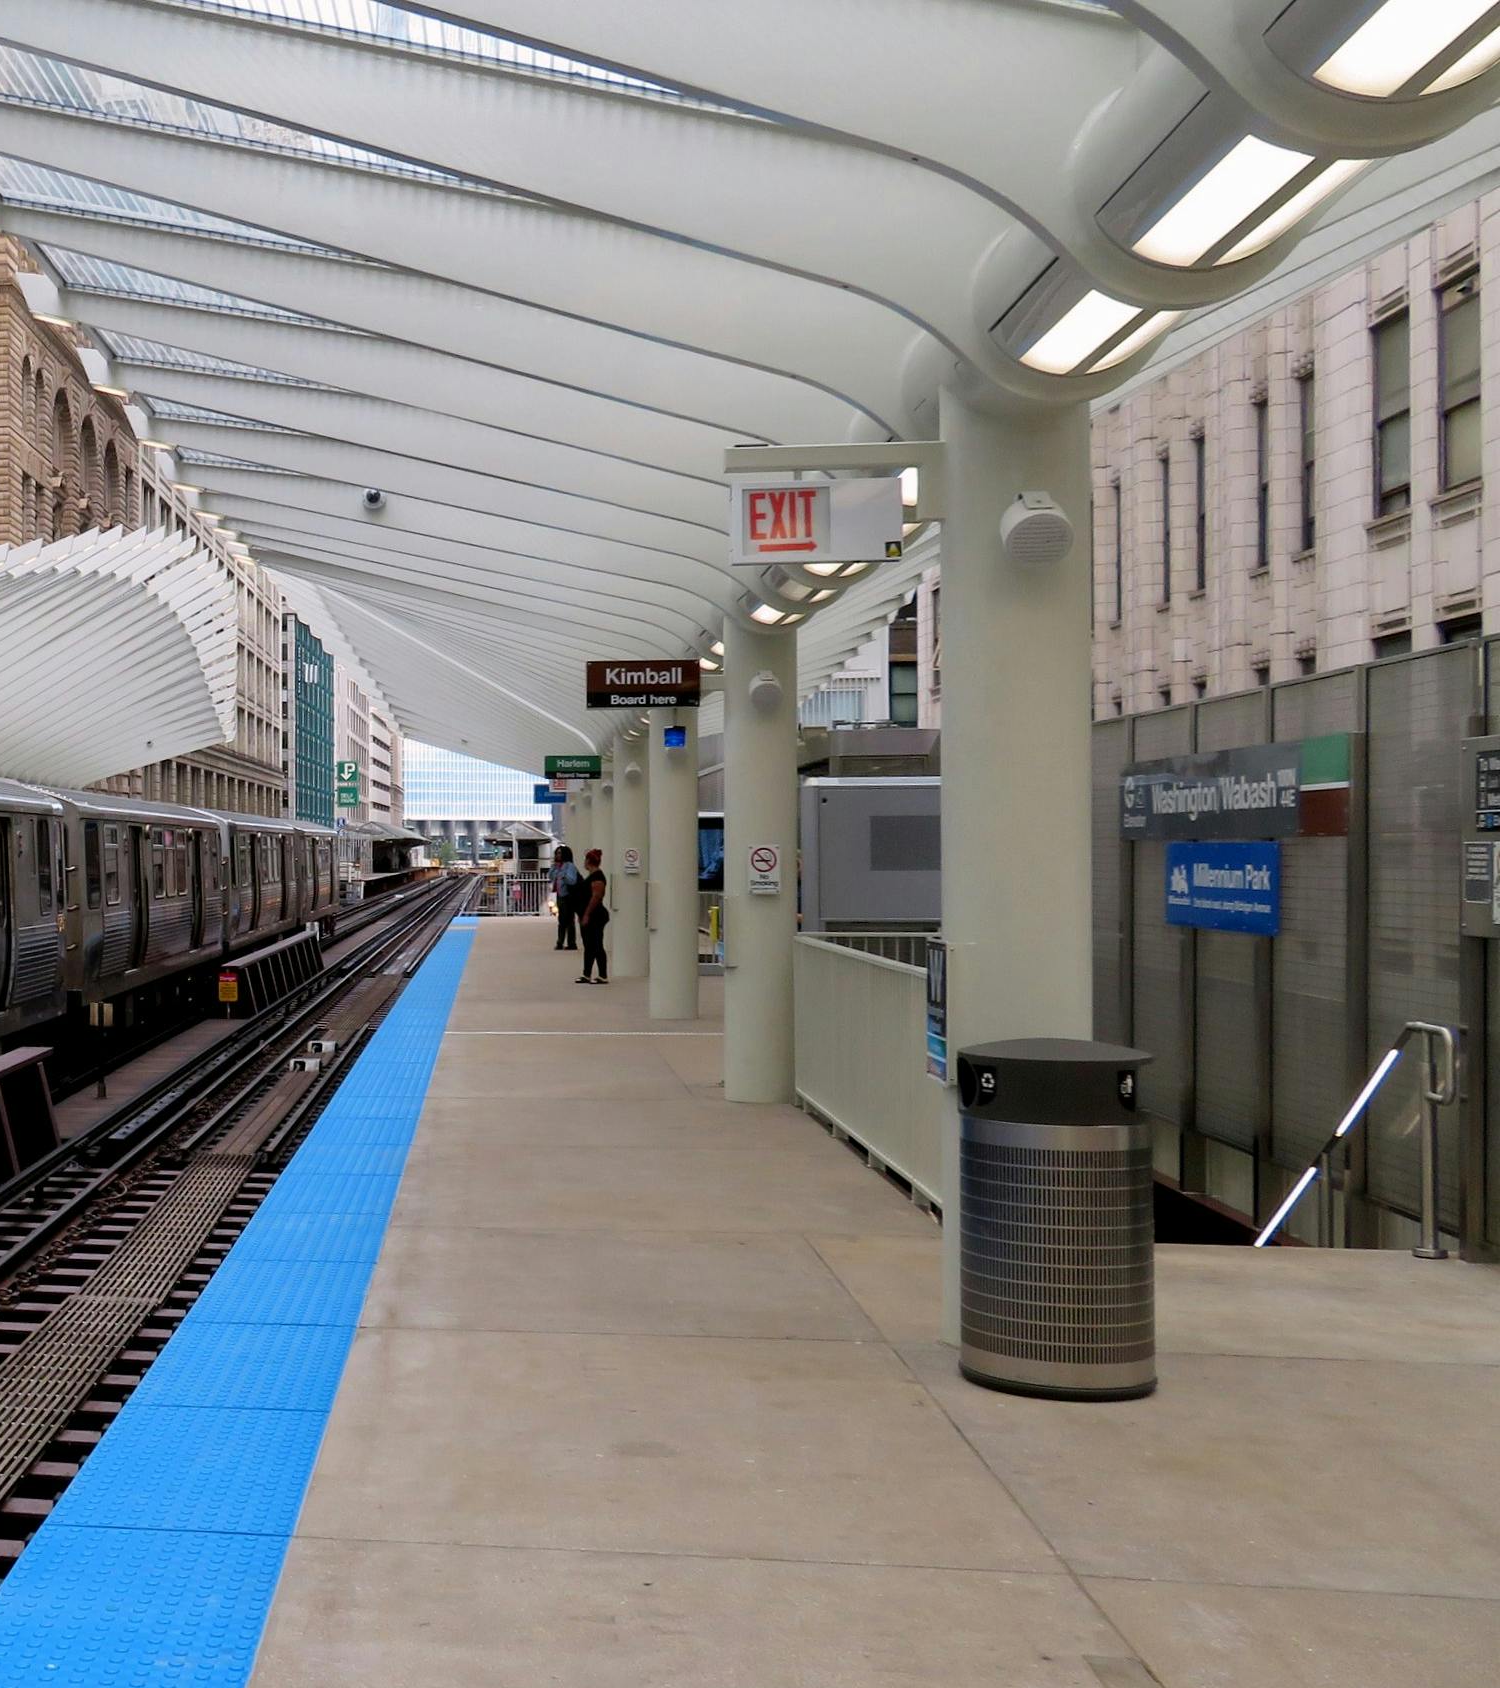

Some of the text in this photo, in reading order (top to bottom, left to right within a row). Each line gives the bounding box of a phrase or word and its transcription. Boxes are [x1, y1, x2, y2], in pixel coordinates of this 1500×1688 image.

[749, 490, 816, 540] EXIT
[605, 667, 683, 685] Kimball
[610, 694, 678, 705] Board here
[556, 759, 591, 769] Harlem
[750, 880, 779, 888] Smoking
[1193, 863, 1271, 891] Millennium Park
